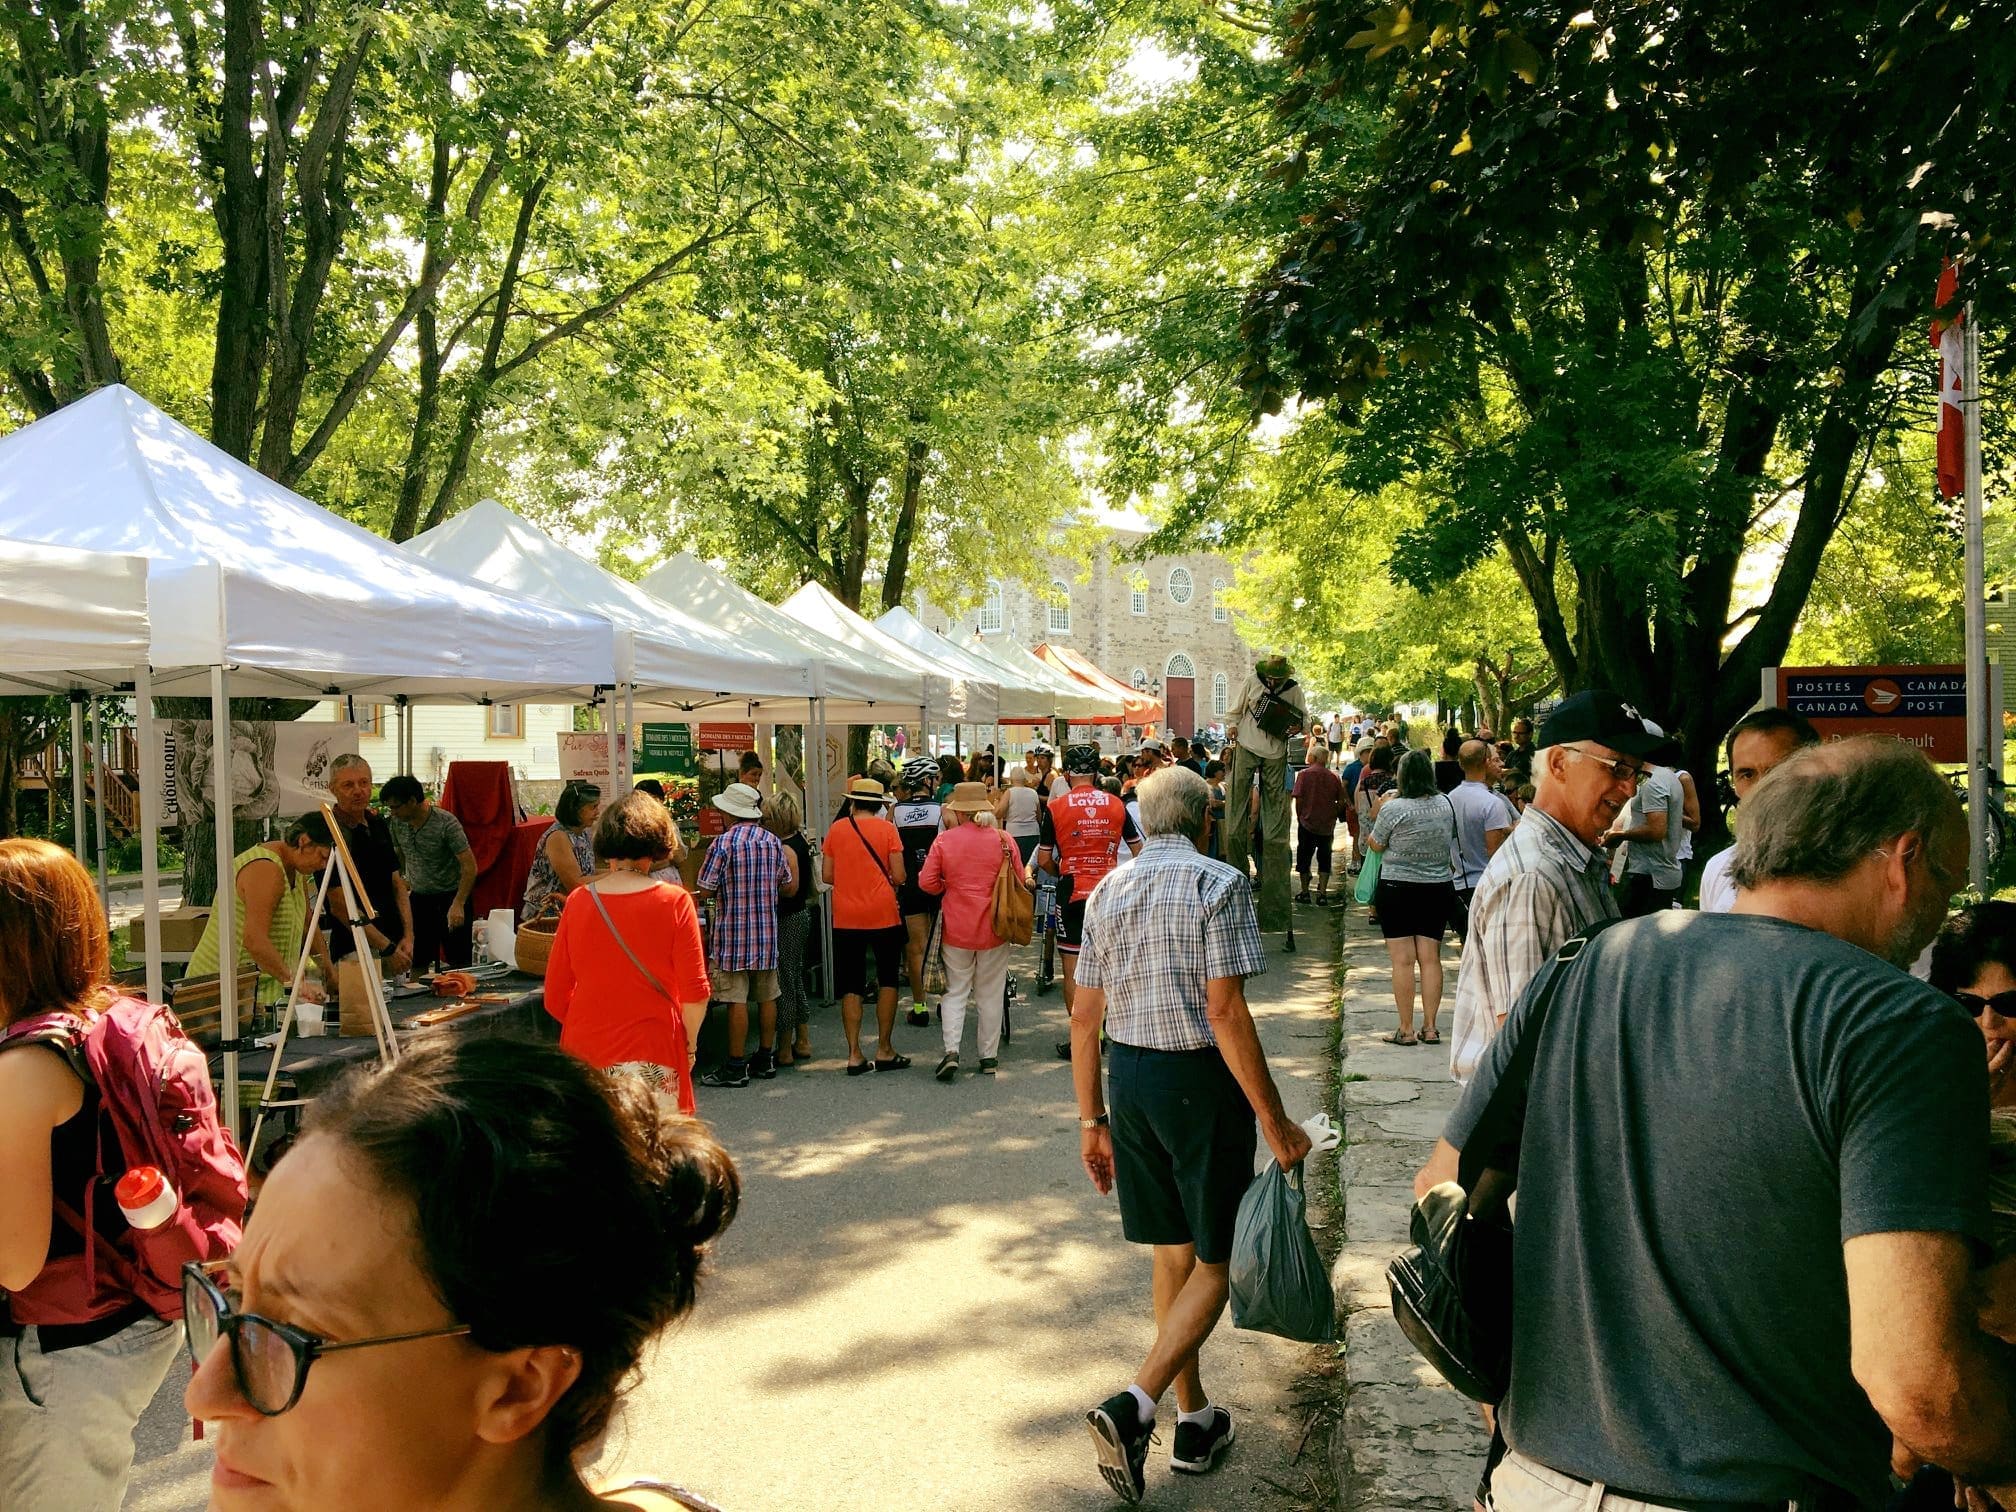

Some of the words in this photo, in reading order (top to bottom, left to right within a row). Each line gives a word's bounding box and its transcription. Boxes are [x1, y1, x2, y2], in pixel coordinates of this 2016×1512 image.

[1796, 682, 1851, 692] POSTES
[1797, 702, 1859, 712] CANADA
[1907, 701, 1945, 711] POST
[163, 730, 178, 814] CHOUCROUTE
[1068, 794, 1110, 807] Laval
